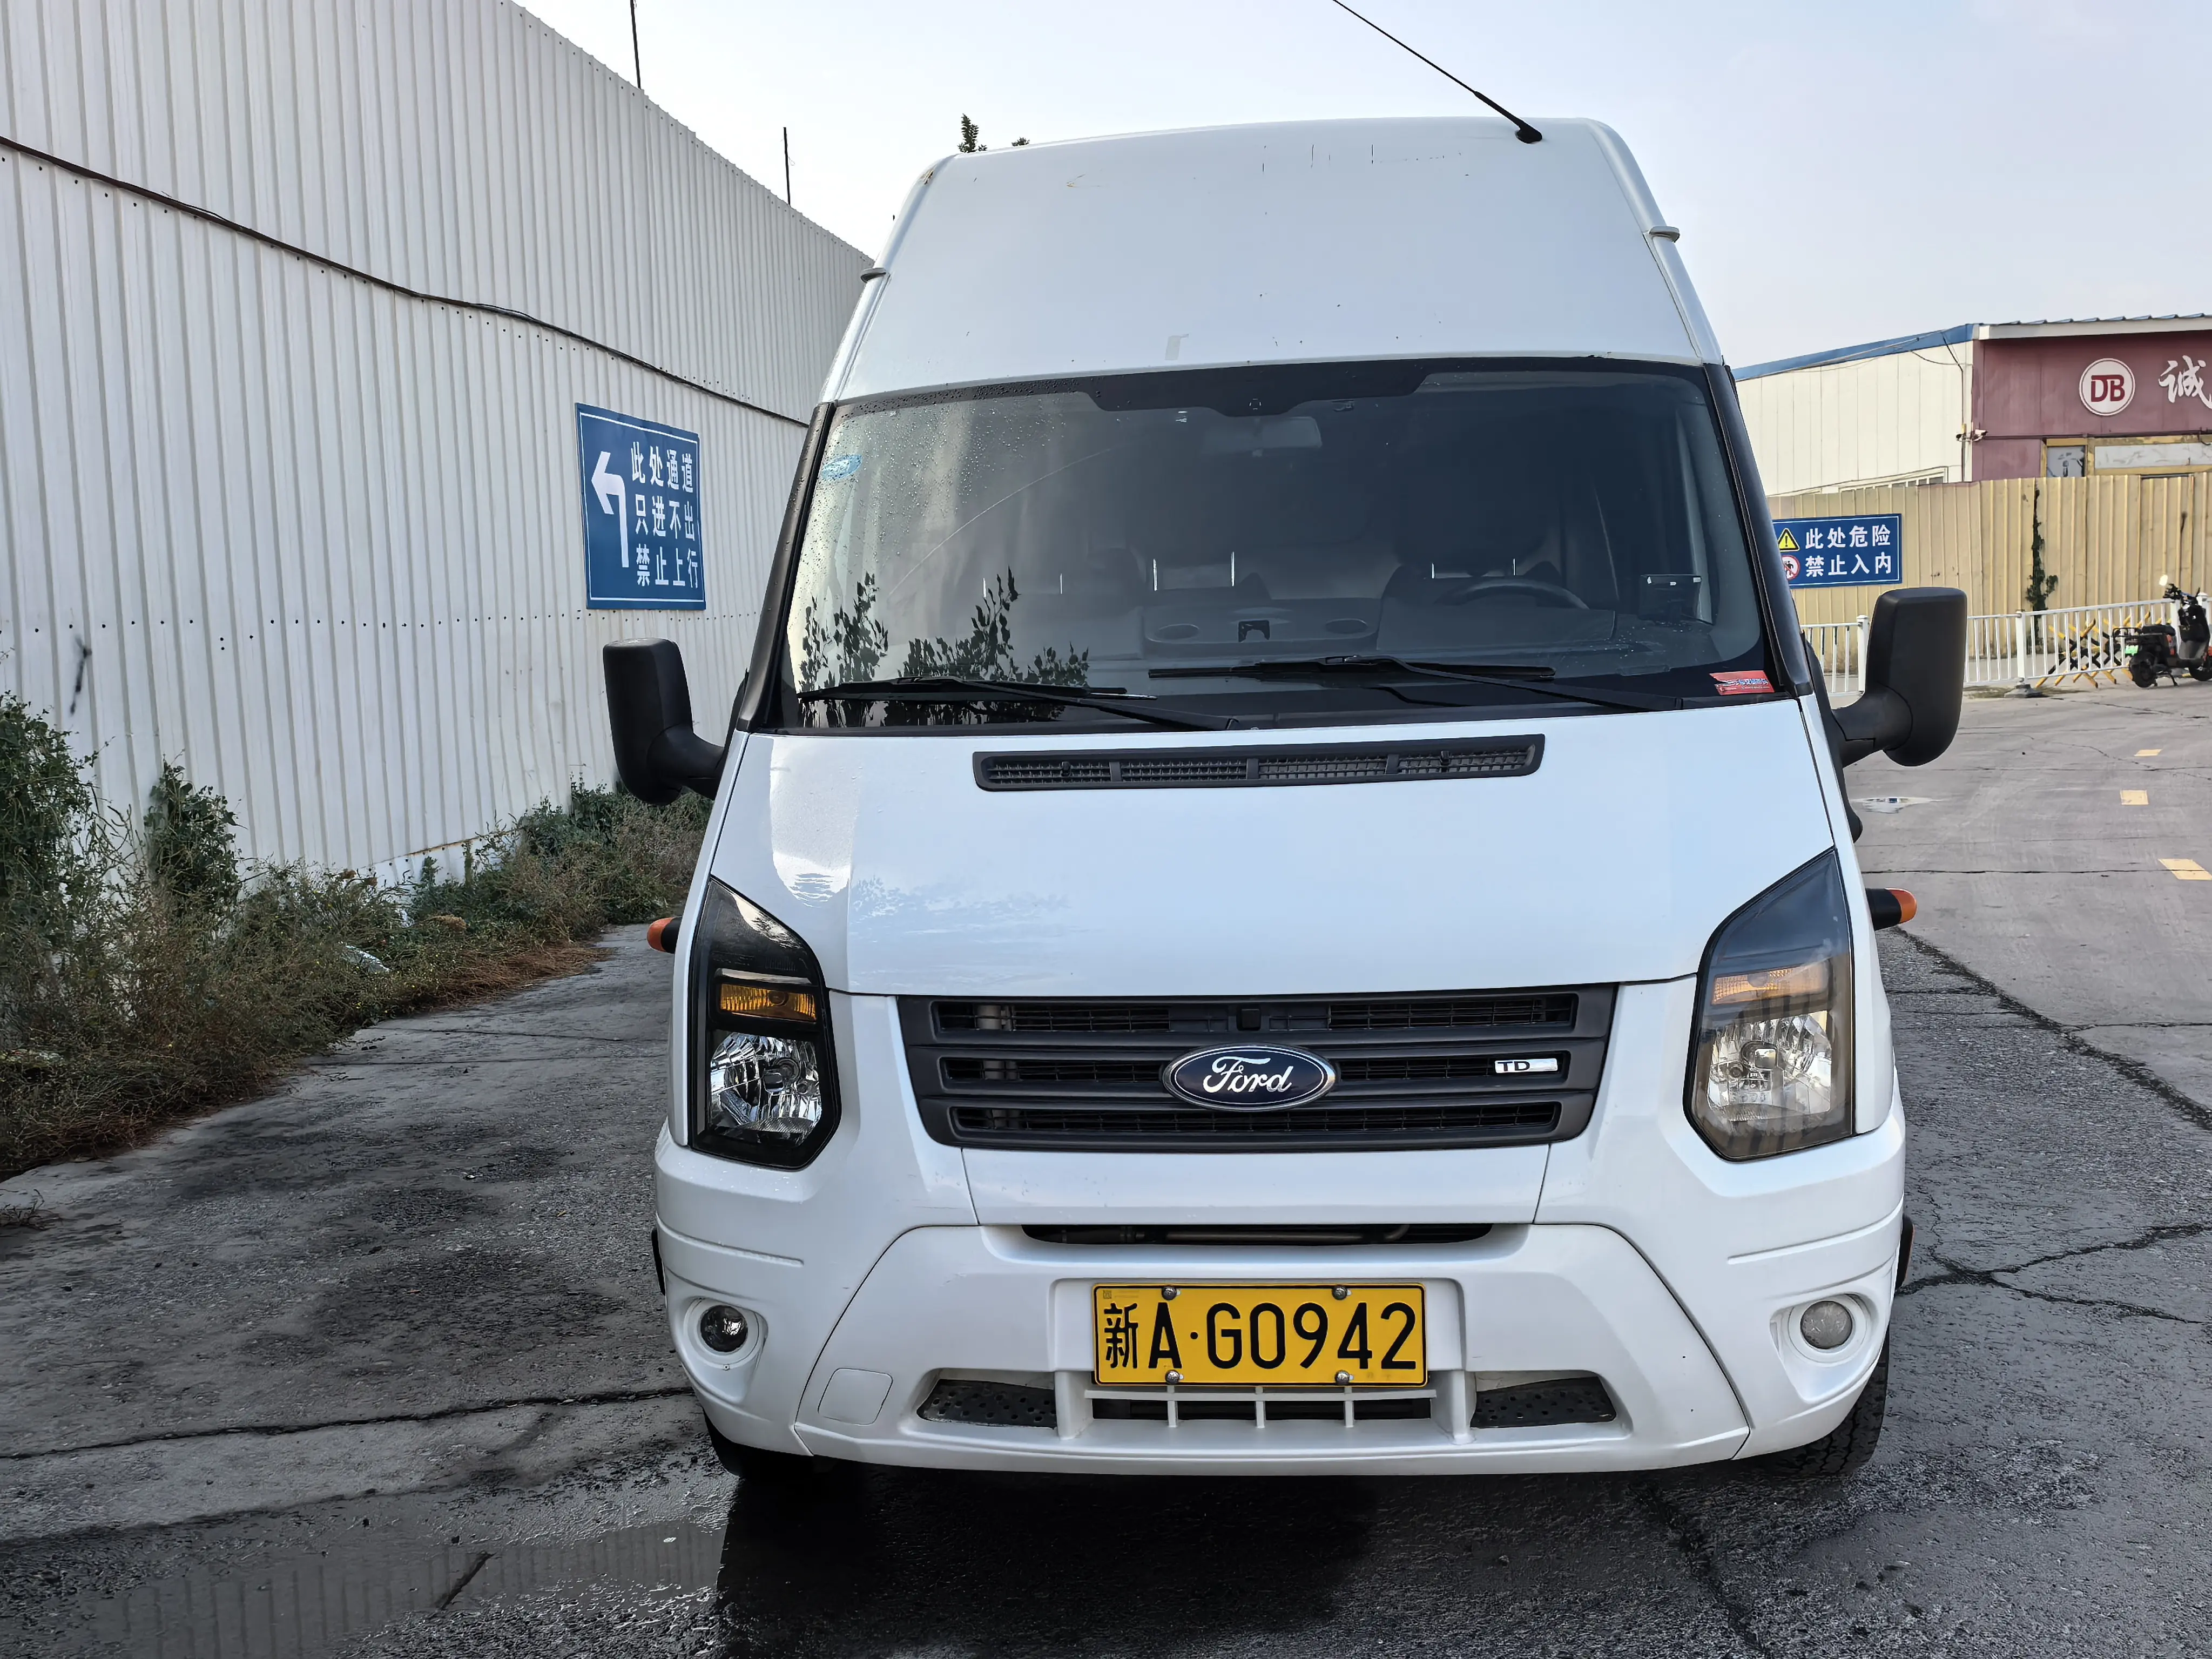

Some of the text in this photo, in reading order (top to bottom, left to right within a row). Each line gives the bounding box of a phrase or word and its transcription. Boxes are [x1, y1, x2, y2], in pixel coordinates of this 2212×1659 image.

[2091, 374, 2125, 402] DB
[630, 441, 693, 493] 此处通道
[635, 494, 695, 541] 只进不出
[1805, 524, 1891, 549] 此处危险
[636, 543, 698, 589] 禁止上行
[1805, 551, 1891, 577] 禁止入内
[1203, 1056, 1294, 1094] Ford
[1497, 1061, 1530, 1072] TD
